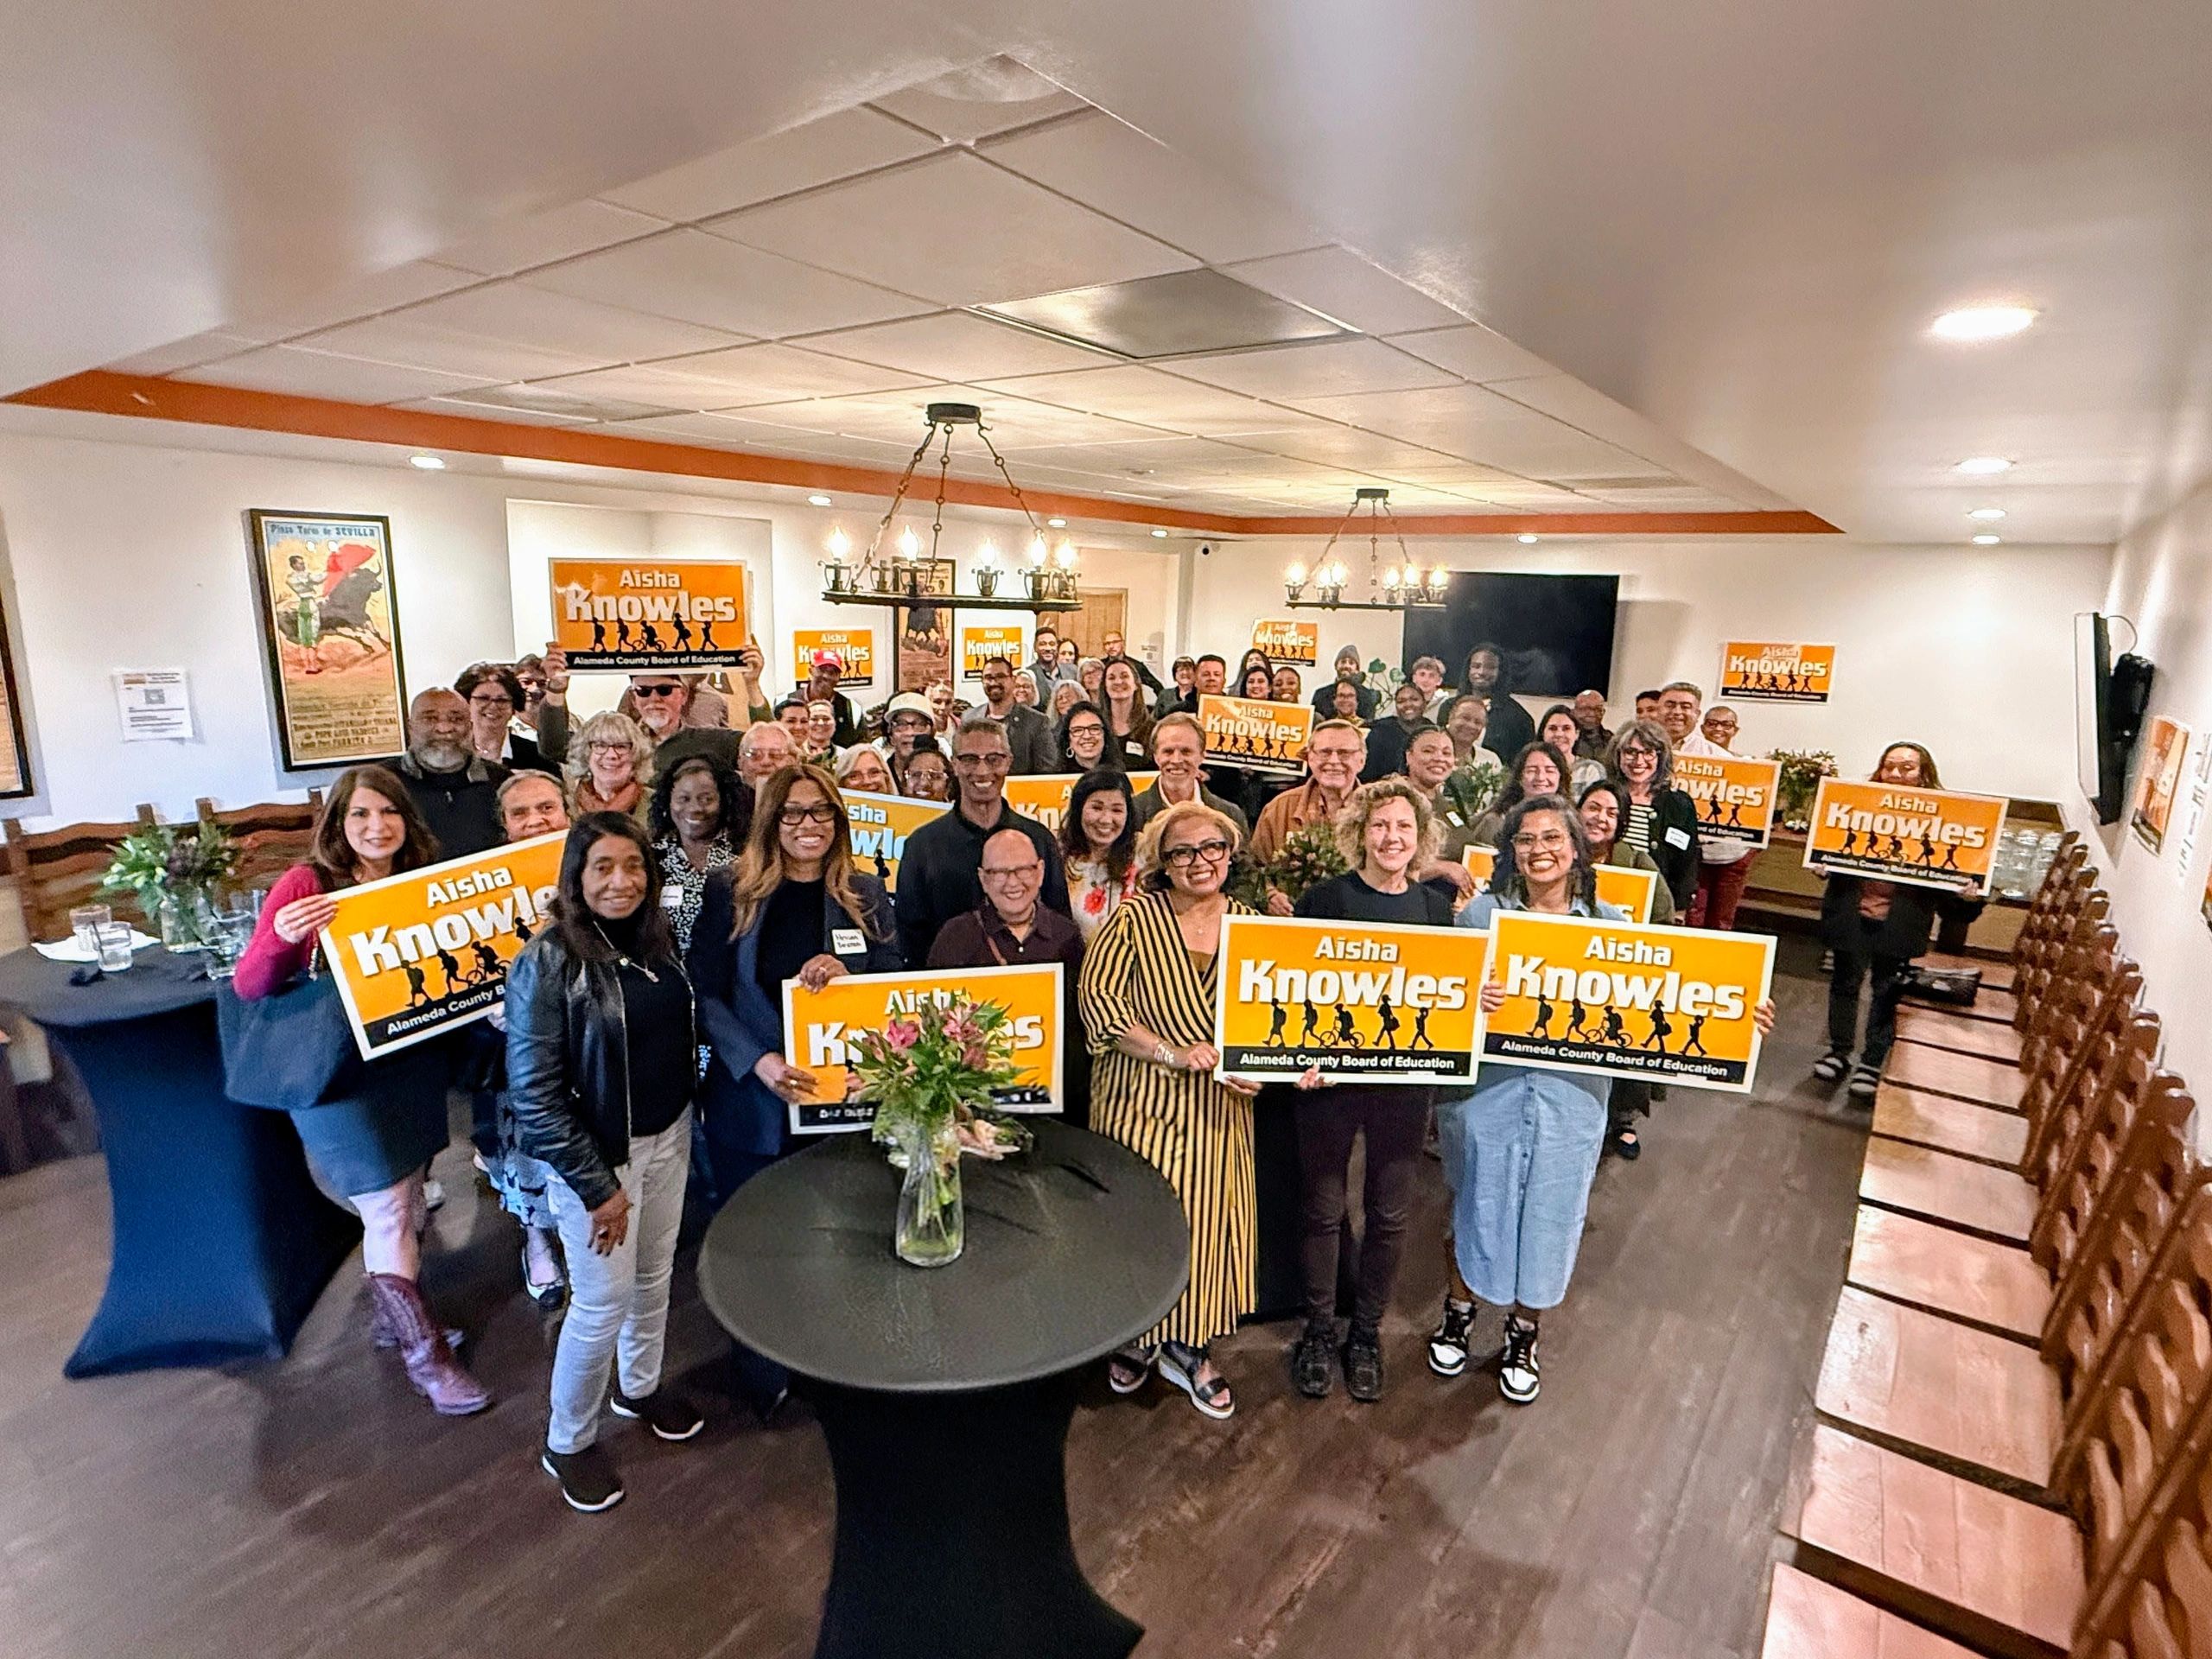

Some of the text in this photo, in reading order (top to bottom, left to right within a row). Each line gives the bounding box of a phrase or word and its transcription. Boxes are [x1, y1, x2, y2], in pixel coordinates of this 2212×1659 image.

[619, 569, 681, 588] Aisha
[565, 588, 736, 622] Knowles
[822, 632, 848, 644] Aisha
[966, 639, 1020, 656] Knowles
[574, 655, 736, 666] Alameda County Board of Education
[1763, 646, 1798, 657] Aisha
[1729, 655, 1827, 677] Knowles
[1239, 704, 1274, 719] Aisha
[1205, 714, 1304, 743] Knowles
[1675, 760, 1723, 777] Aisha
[1671, 777, 1764, 807] owles
[1879, 793, 1939, 814] Aisha
[846, 804, 887, 824] sha
[1825, 802, 1986, 849] Knowles
[426, 867, 514, 908] Aisha
[348, 883, 562, 978] Knowle
[1313, 936, 1398, 962] Aisha
[1585, 935, 1673, 967] Aisha
[1238, 959, 1468, 1009] Knowles
[1506, 954, 1746, 1020] Knowles
[387, 1007, 447, 1035] Alameda
[448, 989, 493, 1012] County
[1240, 1053, 1455, 1070] Alameda County Board of Education
[1501, 1040, 1728, 1077] Alameda County Board of Education
